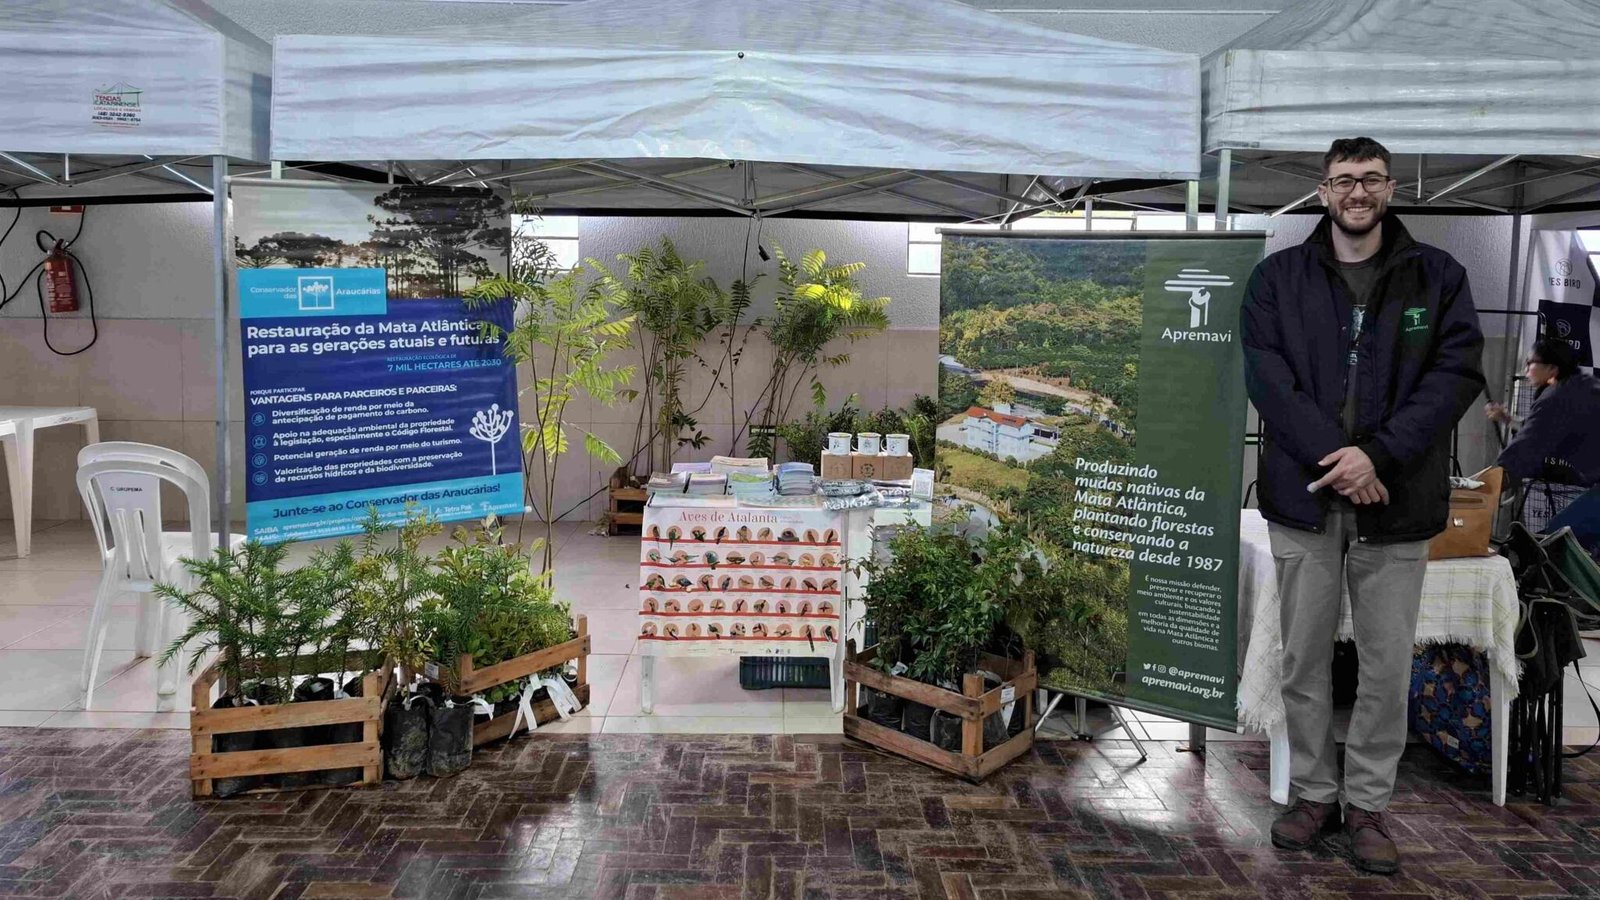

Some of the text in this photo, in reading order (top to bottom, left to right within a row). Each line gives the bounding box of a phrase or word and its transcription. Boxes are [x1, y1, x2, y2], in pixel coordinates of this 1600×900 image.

[1564, 279, 1580, 290] BIRD
[247, 319, 483, 339] Restauração da Mata Atlântica
[1162, 328, 1232, 343] Apremavi
[248, 344, 286, 358] para
[290, 342, 308, 352] as
[312, 338, 386, 354] gerações
[390, 335, 435, 348] atuais
[438, 337, 448, 346] e
[396, 363, 412, 371] MIL
[414, 361, 460, 370] HECTARES
[482, 358, 502, 366] 2030
[251, 394, 312, 405] VANTAGENS
[314, 392, 342, 400] PARA
[344, 388, 397, 398] PARCEIROS
[406, 384, 458, 394] PARCEIRAS:
[272, 406, 330, 417] Diversificação
[272, 414, 324, 424] antecipação
[337, 410, 384, 420] pagamento
[273, 431, 298, 440] Apoio
[312, 426, 356, 437] adequação
[358, 422, 398, 432] ambiental
[410, 418, 454, 428] propriedade
[280, 436, 324, 446] legislação,
[326, 430, 384, 442] especialmente
[392, 427, 418, 436] Código
[420, 425, 453, 434] Florestal.
[274, 452, 313, 460] Potencial
[316, 448, 348, 458] geração
[274, 465, 322, 476] Valorização
[340, 458, 392, 471] propriedades
[418, 452, 462, 462] preservação
[288, 473, 323, 482] recursos
[324, 469, 356, 478] hídricos
[376, 462, 434, 472] biodiversidade.
[1076, 458, 1158, 478] Produzindo
[1074, 476, 1205, 501] mudas nativas da
[273, 483, 500, 518] Junte-se ao Conservador das Araucárias!
[1074, 490, 1187, 518] Mata Atlântica,
[680, 511, 707, 522] Aves
[710, 511, 724, 522] de
[728, 512, 778, 524] Atalanta
[1073, 507, 1214, 536] plantando florestas
[254, 526, 278, 535] SAIBA
[1072, 525, 1189, 550] e conservando a
[1072, 540, 1223, 572] natureza desde 1987
[1150, 584, 1178, 592] preservar
[1185, 590, 1216, 598] recuperar
[1169, 580, 1190, 588] missão
[1154, 592, 1184, 600] ambiente
[1199, 599, 1222, 607] valores
[1169, 608, 1220, 621] sustentabilidade
[1184, 603, 1216, 613] buscando
[1140, 618, 1168, 628] melhoria
[1178, 624, 1210, 634] qualidade
[1176, 616, 1210, 627] dimensões
[1167, 630, 1184, 638] Mata
[1185, 632, 1214, 642] Atlântica
[1172, 638, 1218, 651] outros biomas.
[1168, 666, 1224, 684] @apremavi
[1142, 676, 1224, 698] apremavi.org.br
